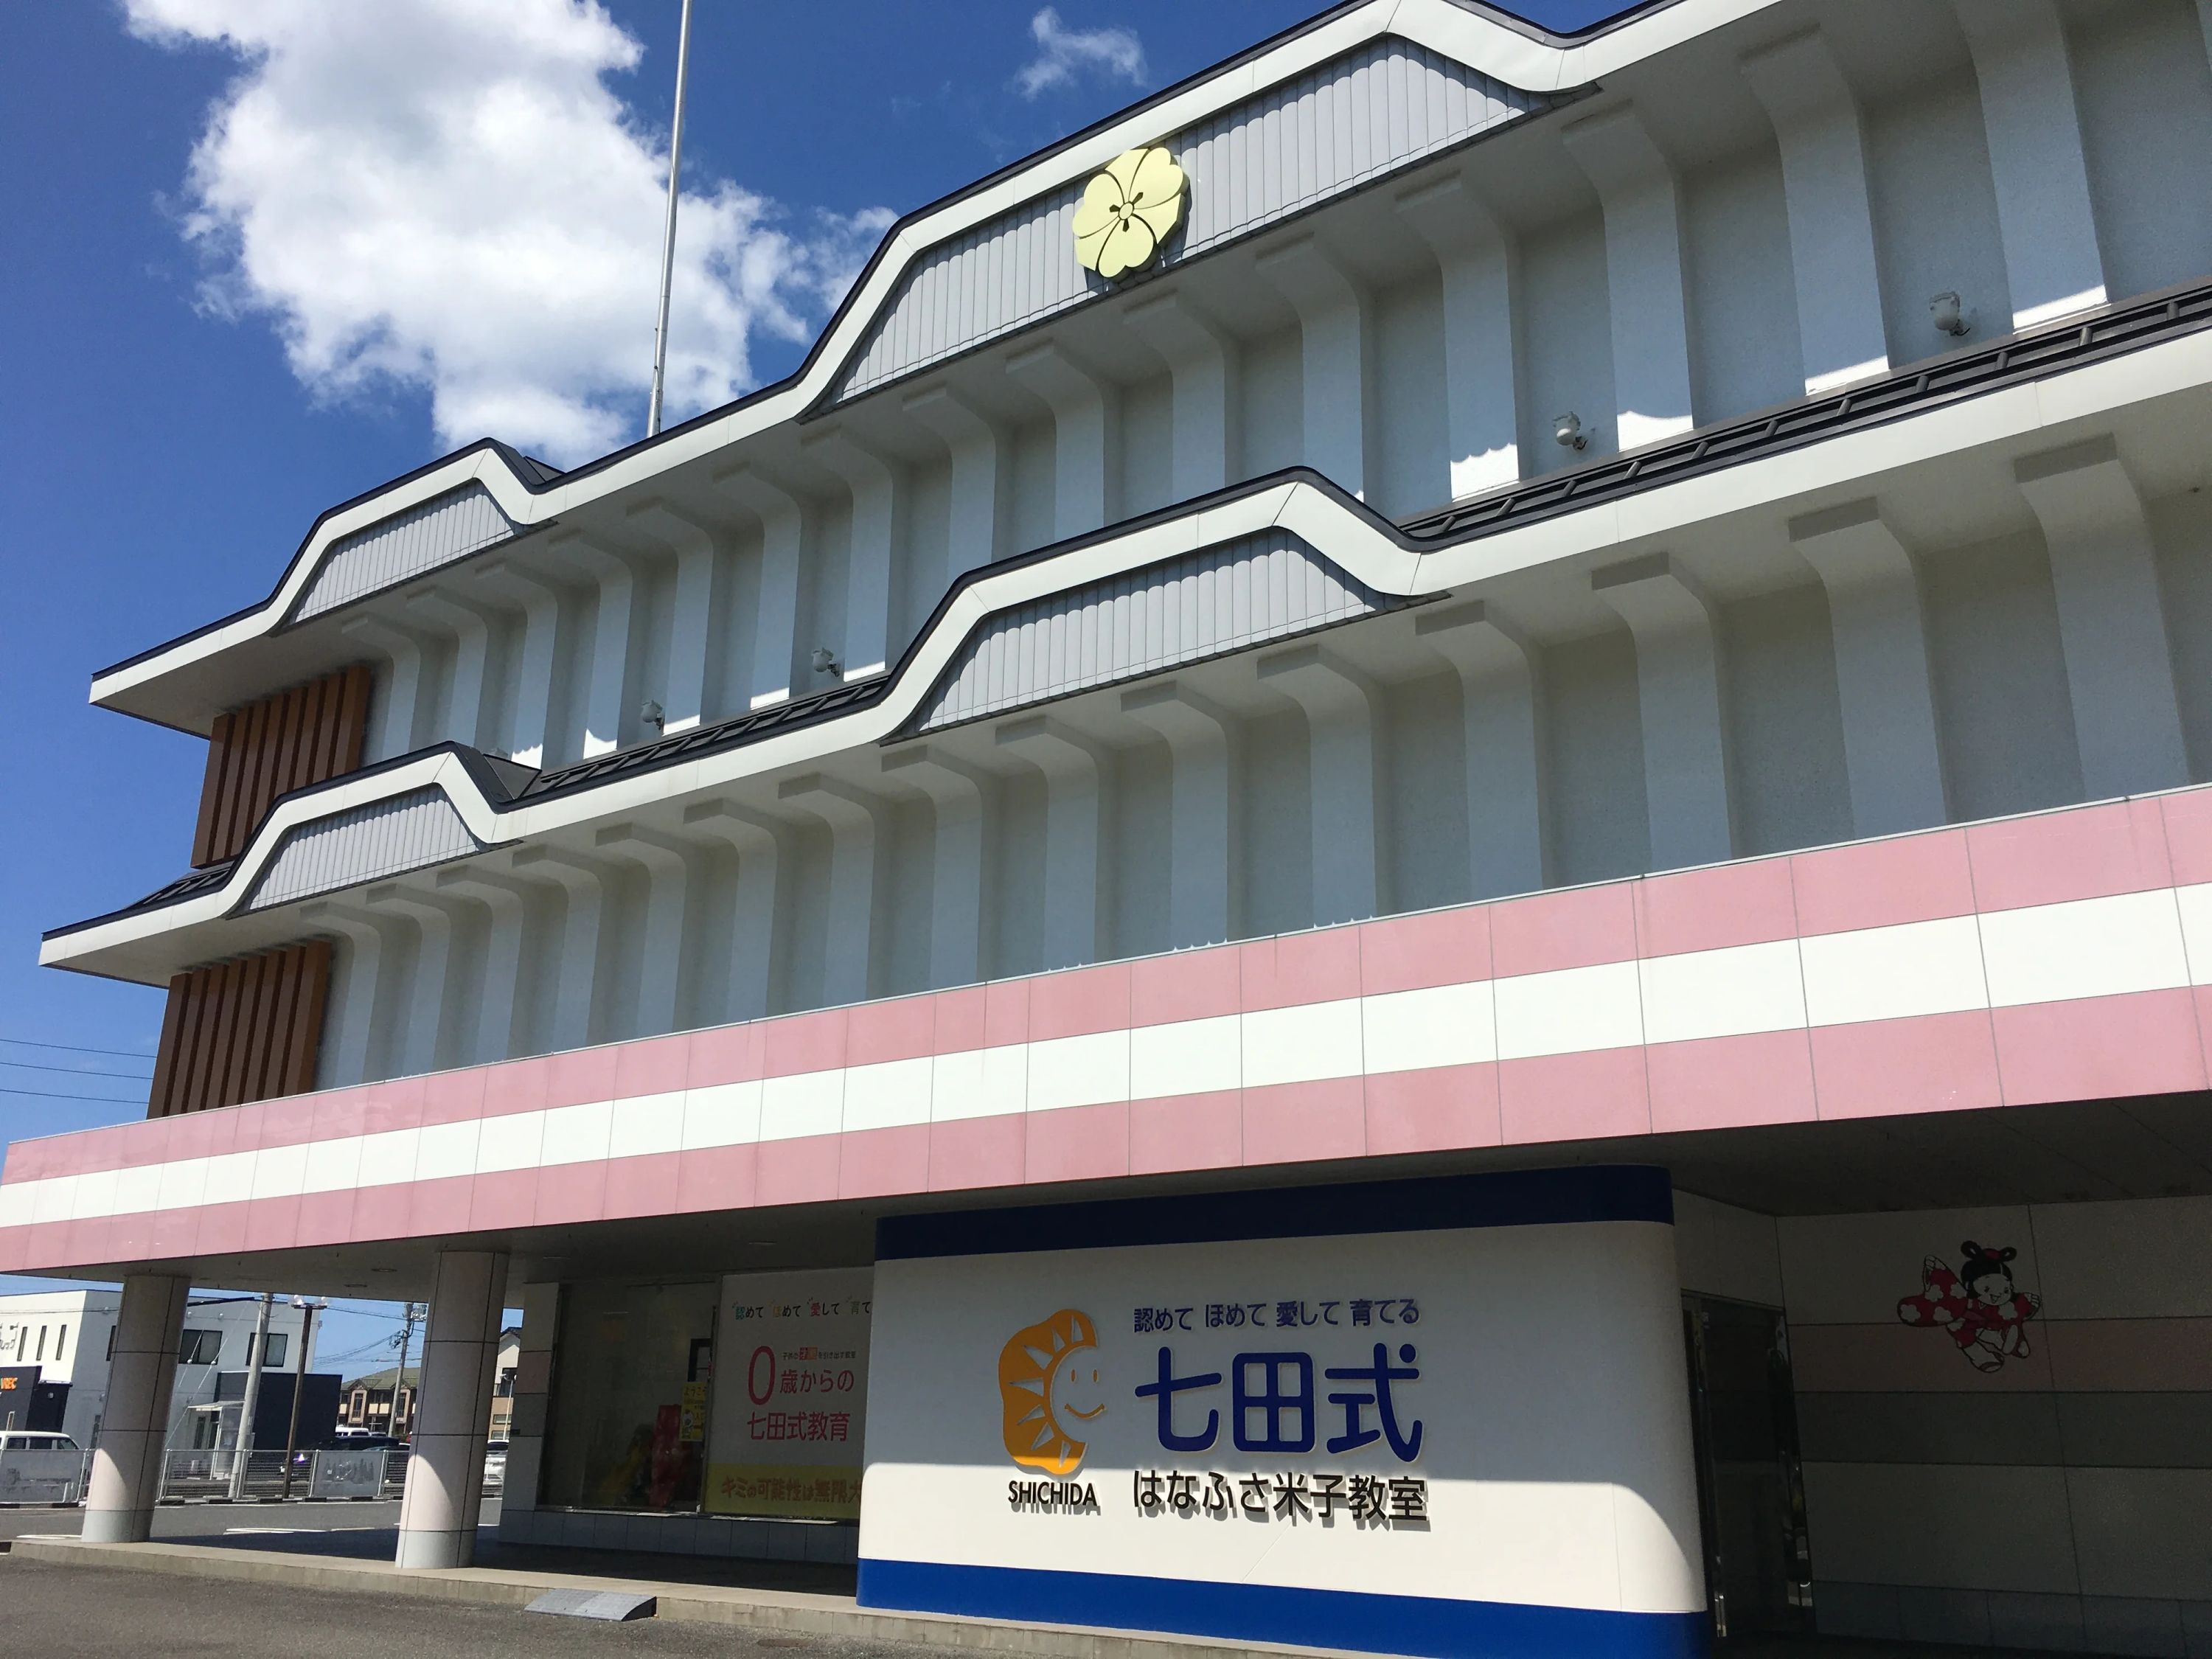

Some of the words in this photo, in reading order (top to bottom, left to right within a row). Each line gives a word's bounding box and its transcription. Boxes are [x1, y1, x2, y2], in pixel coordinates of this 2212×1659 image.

[810, 1302, 840, 1317] 愛して
[1133, 1307, 1194, 1333] 認めて
[1205, 1302, 1267, 1329] ほめて
[1276, 1300, 1340, 1327] 愛して
[1350, 1298, 1420, 1326] 育てる
[1134, 1342, 1423, 1462] 七田式
[747, 1411, 850, 1442] 七田式教育
[1008, 1481, 1098, 1507] SHICHIDA
[1133, 1470, 1427, 1522] はなふさ米子教室
